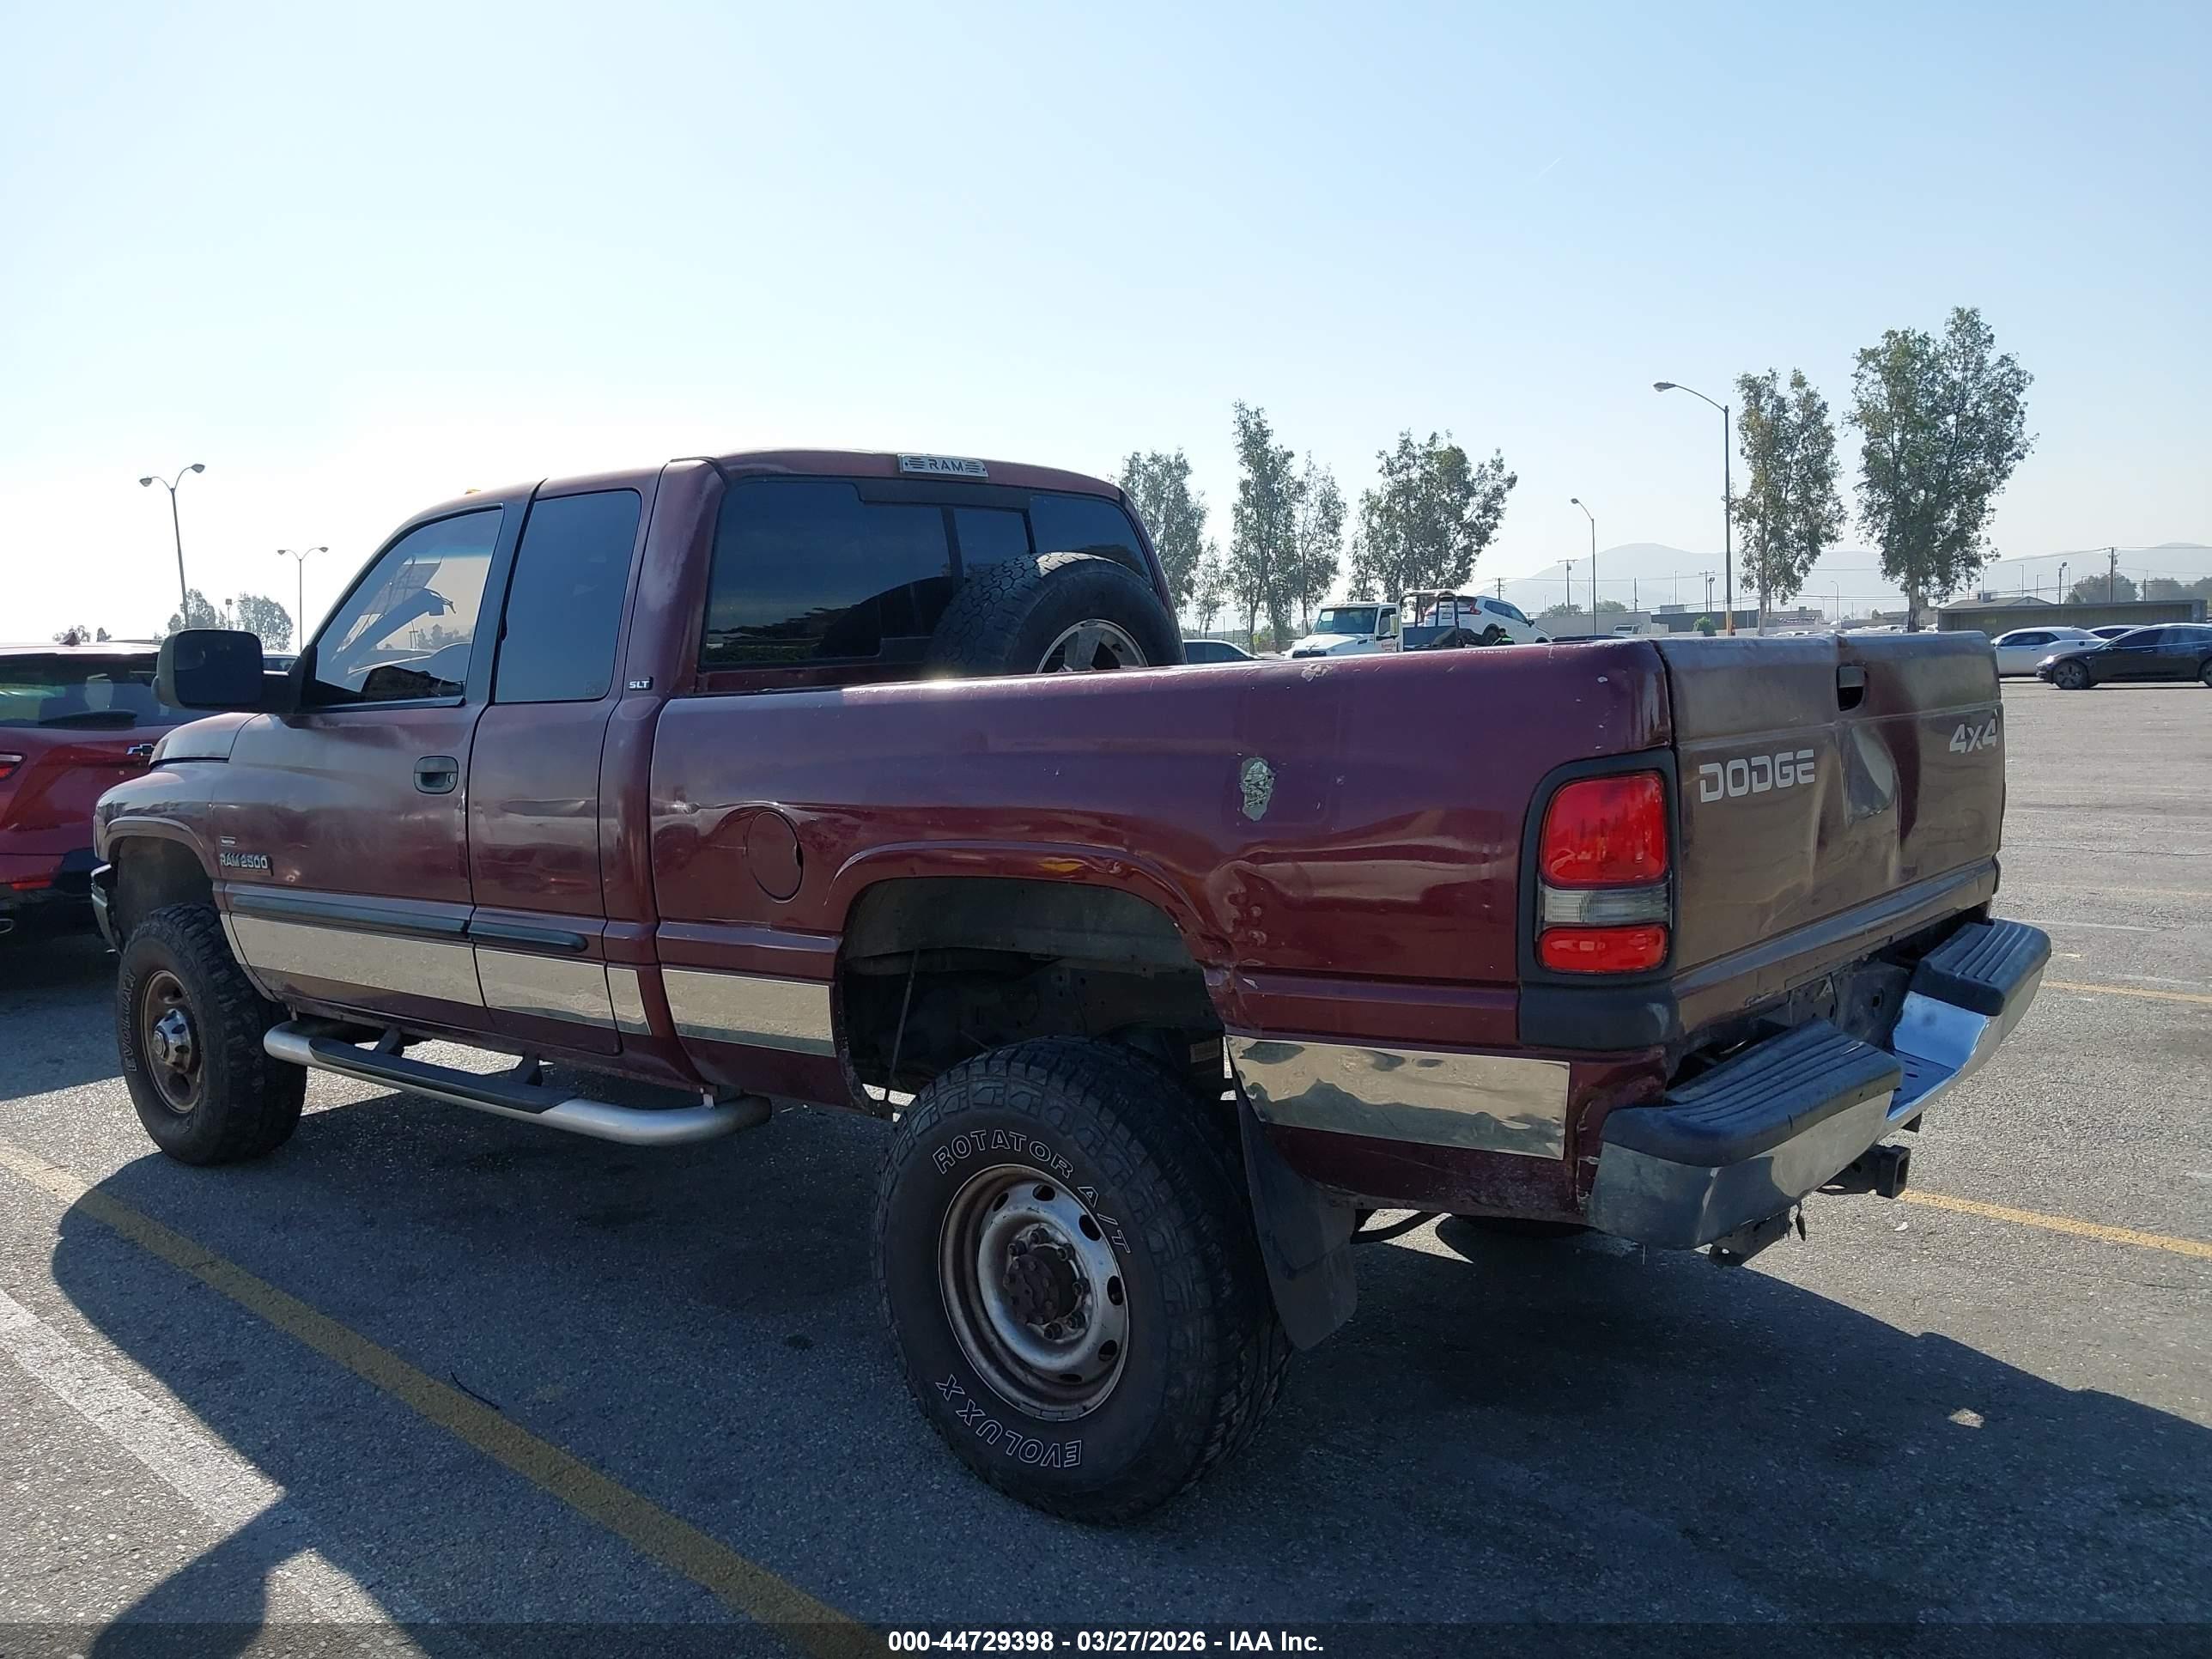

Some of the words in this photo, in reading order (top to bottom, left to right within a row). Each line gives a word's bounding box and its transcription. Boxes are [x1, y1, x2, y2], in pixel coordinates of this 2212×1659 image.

[928, 459, 963, 471] RAM
[629, 680, 650, 689] SLT
[1699, 749, 1815, 803] DODGE
[220, 853, 240, 866] RAM
[240, 854, 268, 869] 2500
[933, 1129, 1073, 1179] ROTATOR
[1077, 1186, 1131, 1254] A/T
[934, 1374, 1082, 1468] EVOLUXX
